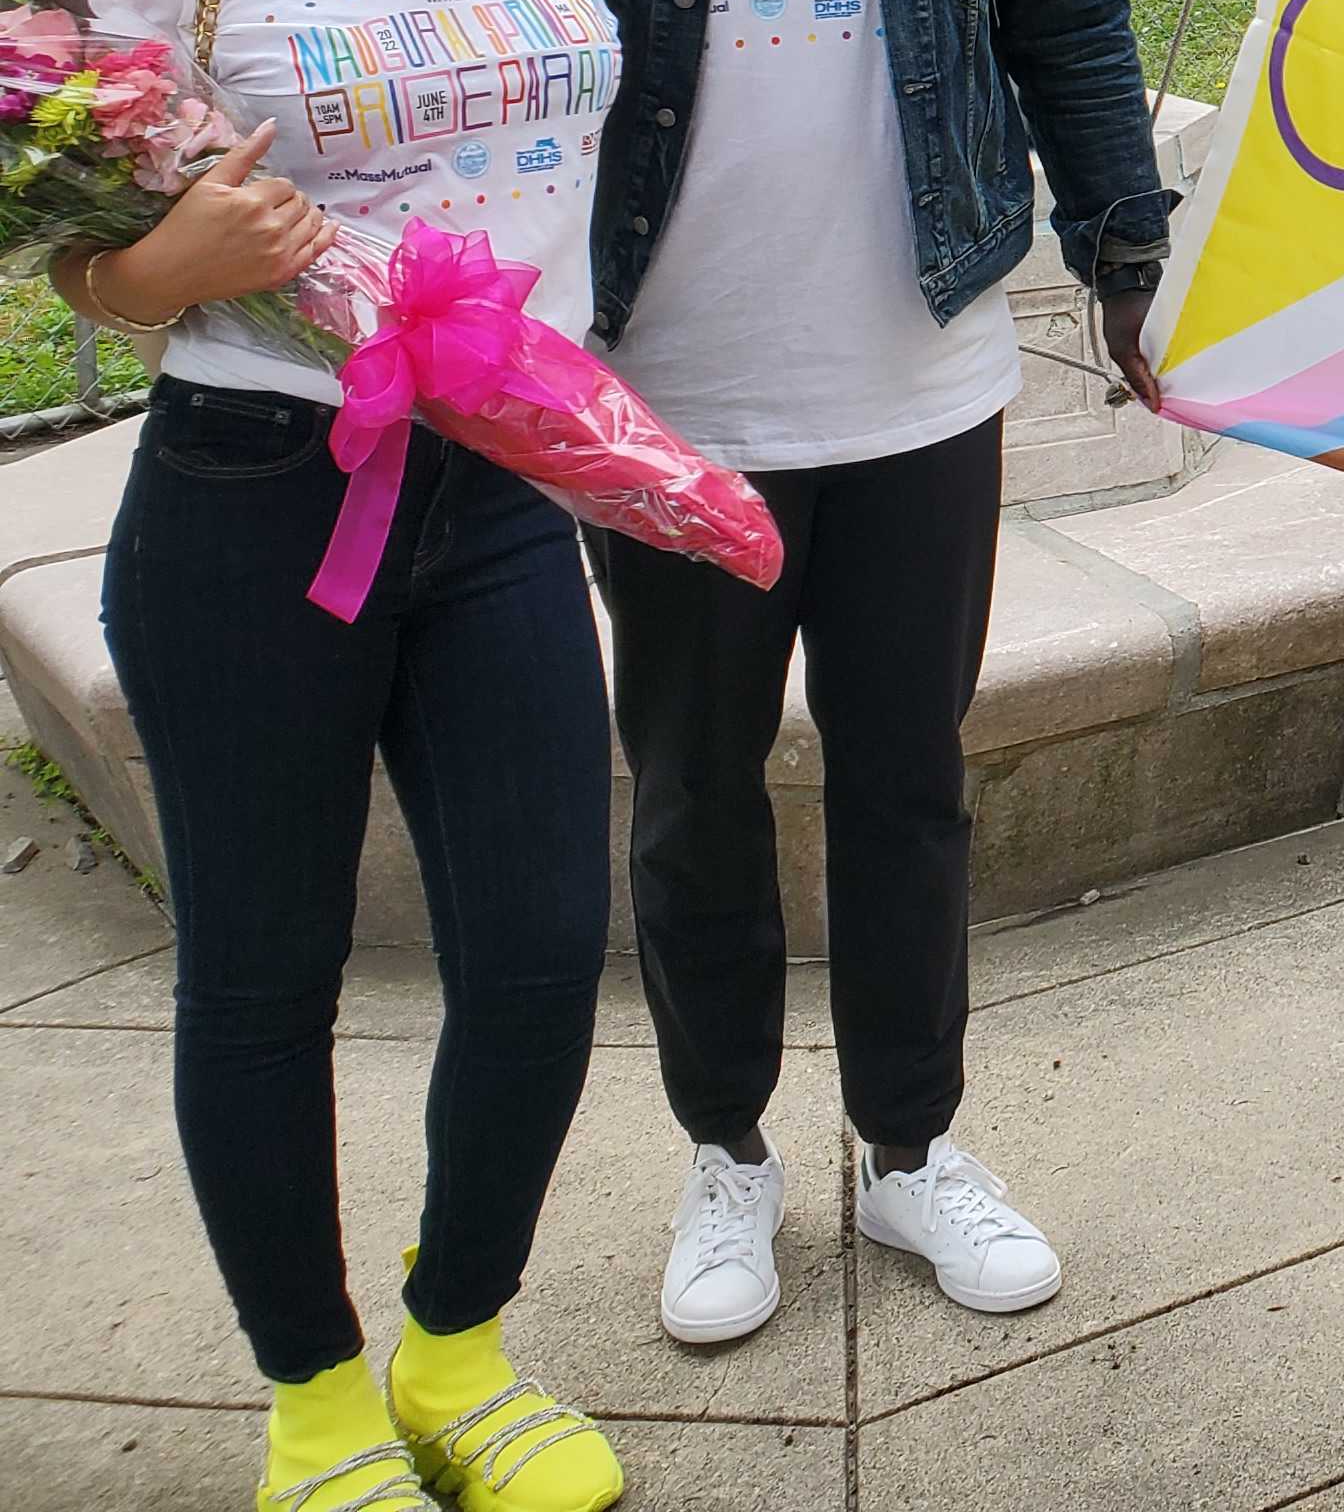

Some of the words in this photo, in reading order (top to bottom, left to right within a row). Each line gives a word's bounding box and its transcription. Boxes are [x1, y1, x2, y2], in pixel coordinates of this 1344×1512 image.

[815, 0, 862, 14] DHHS
[288, 8, 487, 95] INAUGURAL
[416, 90, 448, 108] JUNE
[304, 64, 493, 155] PRIDE
[315, 102, 340, 115] 10AM
[422, 105, 445, 122] 4TH
[516, 151, 562, 167] DHHS
[344, 158, 432, 183] MassMutual
